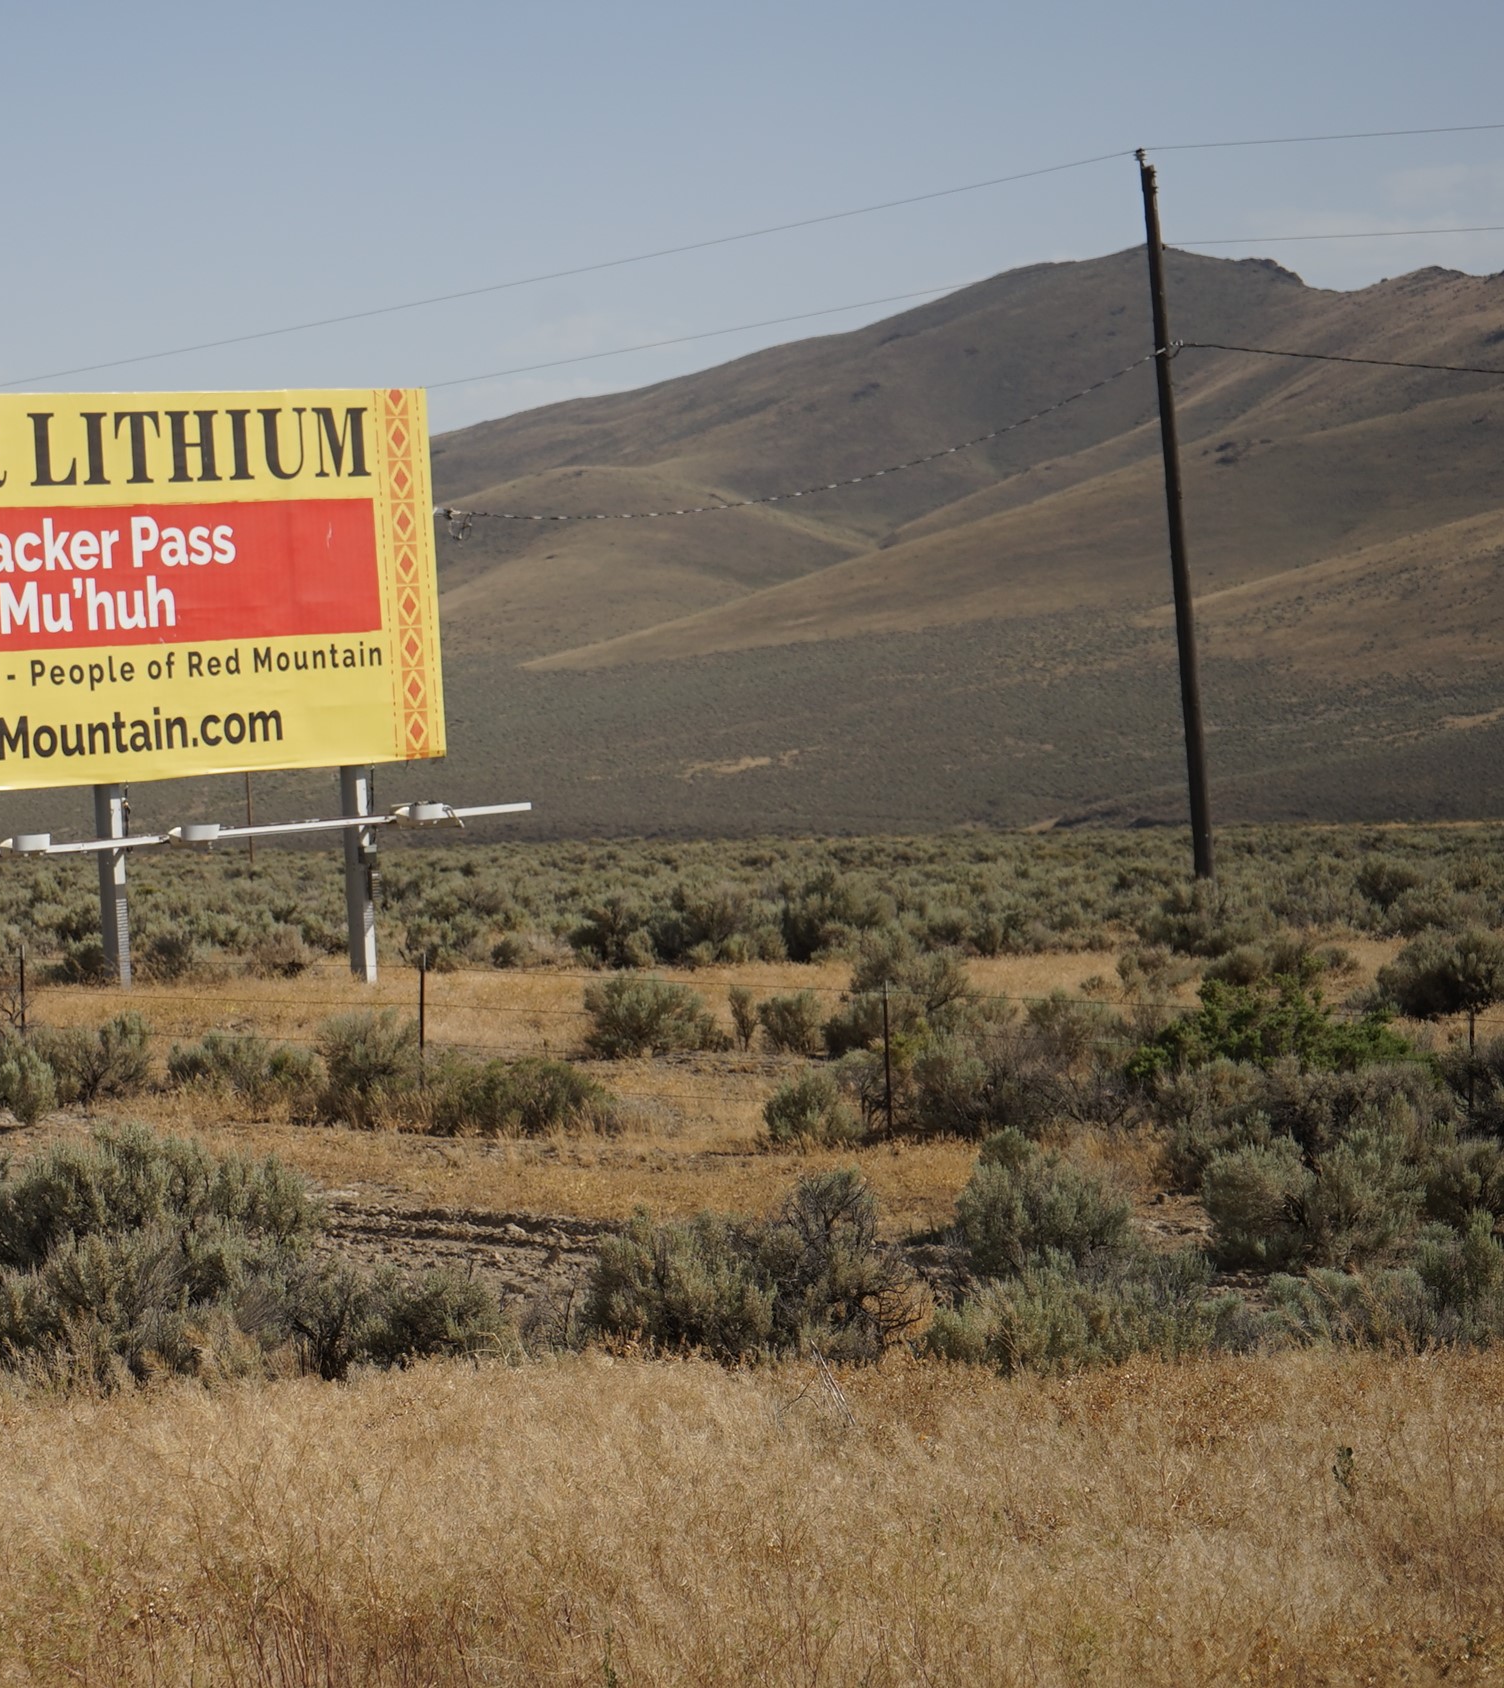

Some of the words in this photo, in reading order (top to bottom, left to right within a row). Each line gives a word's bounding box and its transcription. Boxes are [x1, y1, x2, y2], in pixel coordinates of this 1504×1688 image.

[26, 407, 372, 487] LITHIUM
[130, 515, 236, 568] Pass
[30, 655, 135, 692] People
[147, 651, 175, 680] of
[187, 647, 241, 678] Red
[253, 643, 382, 673] Mountain
